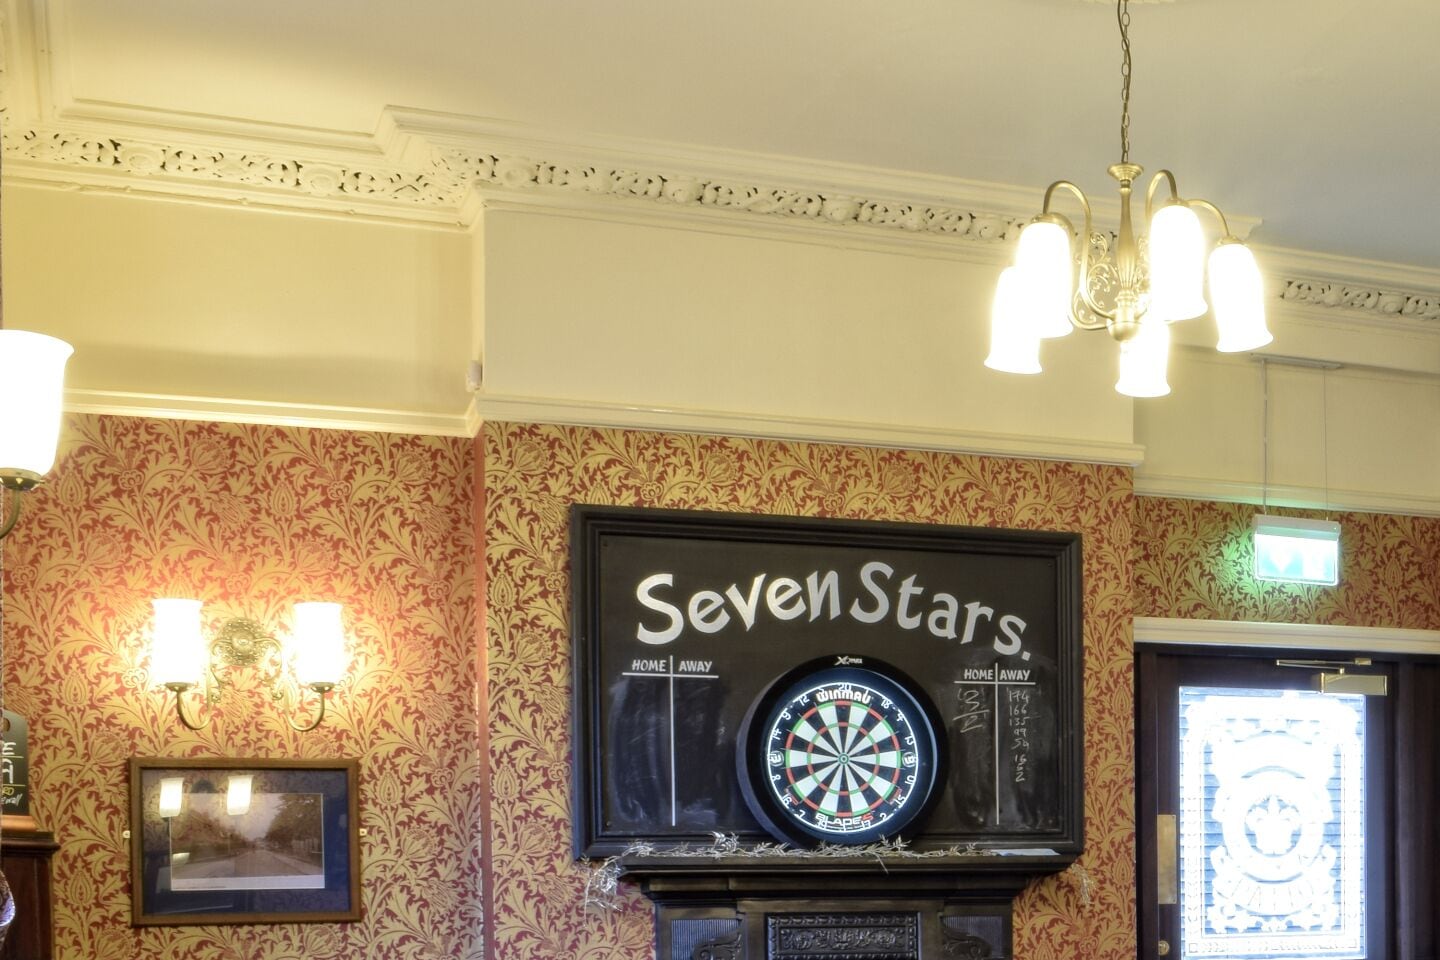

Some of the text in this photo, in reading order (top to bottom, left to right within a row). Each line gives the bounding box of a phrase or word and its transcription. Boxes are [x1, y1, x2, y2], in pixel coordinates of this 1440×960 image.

[636, 569, 842, 645] Seven
[631, 659, 713, 673] HOME AWAY
[963, 669, 1031, 681] HOME AWAY
[816, 689, 871, 704] WINMAU
